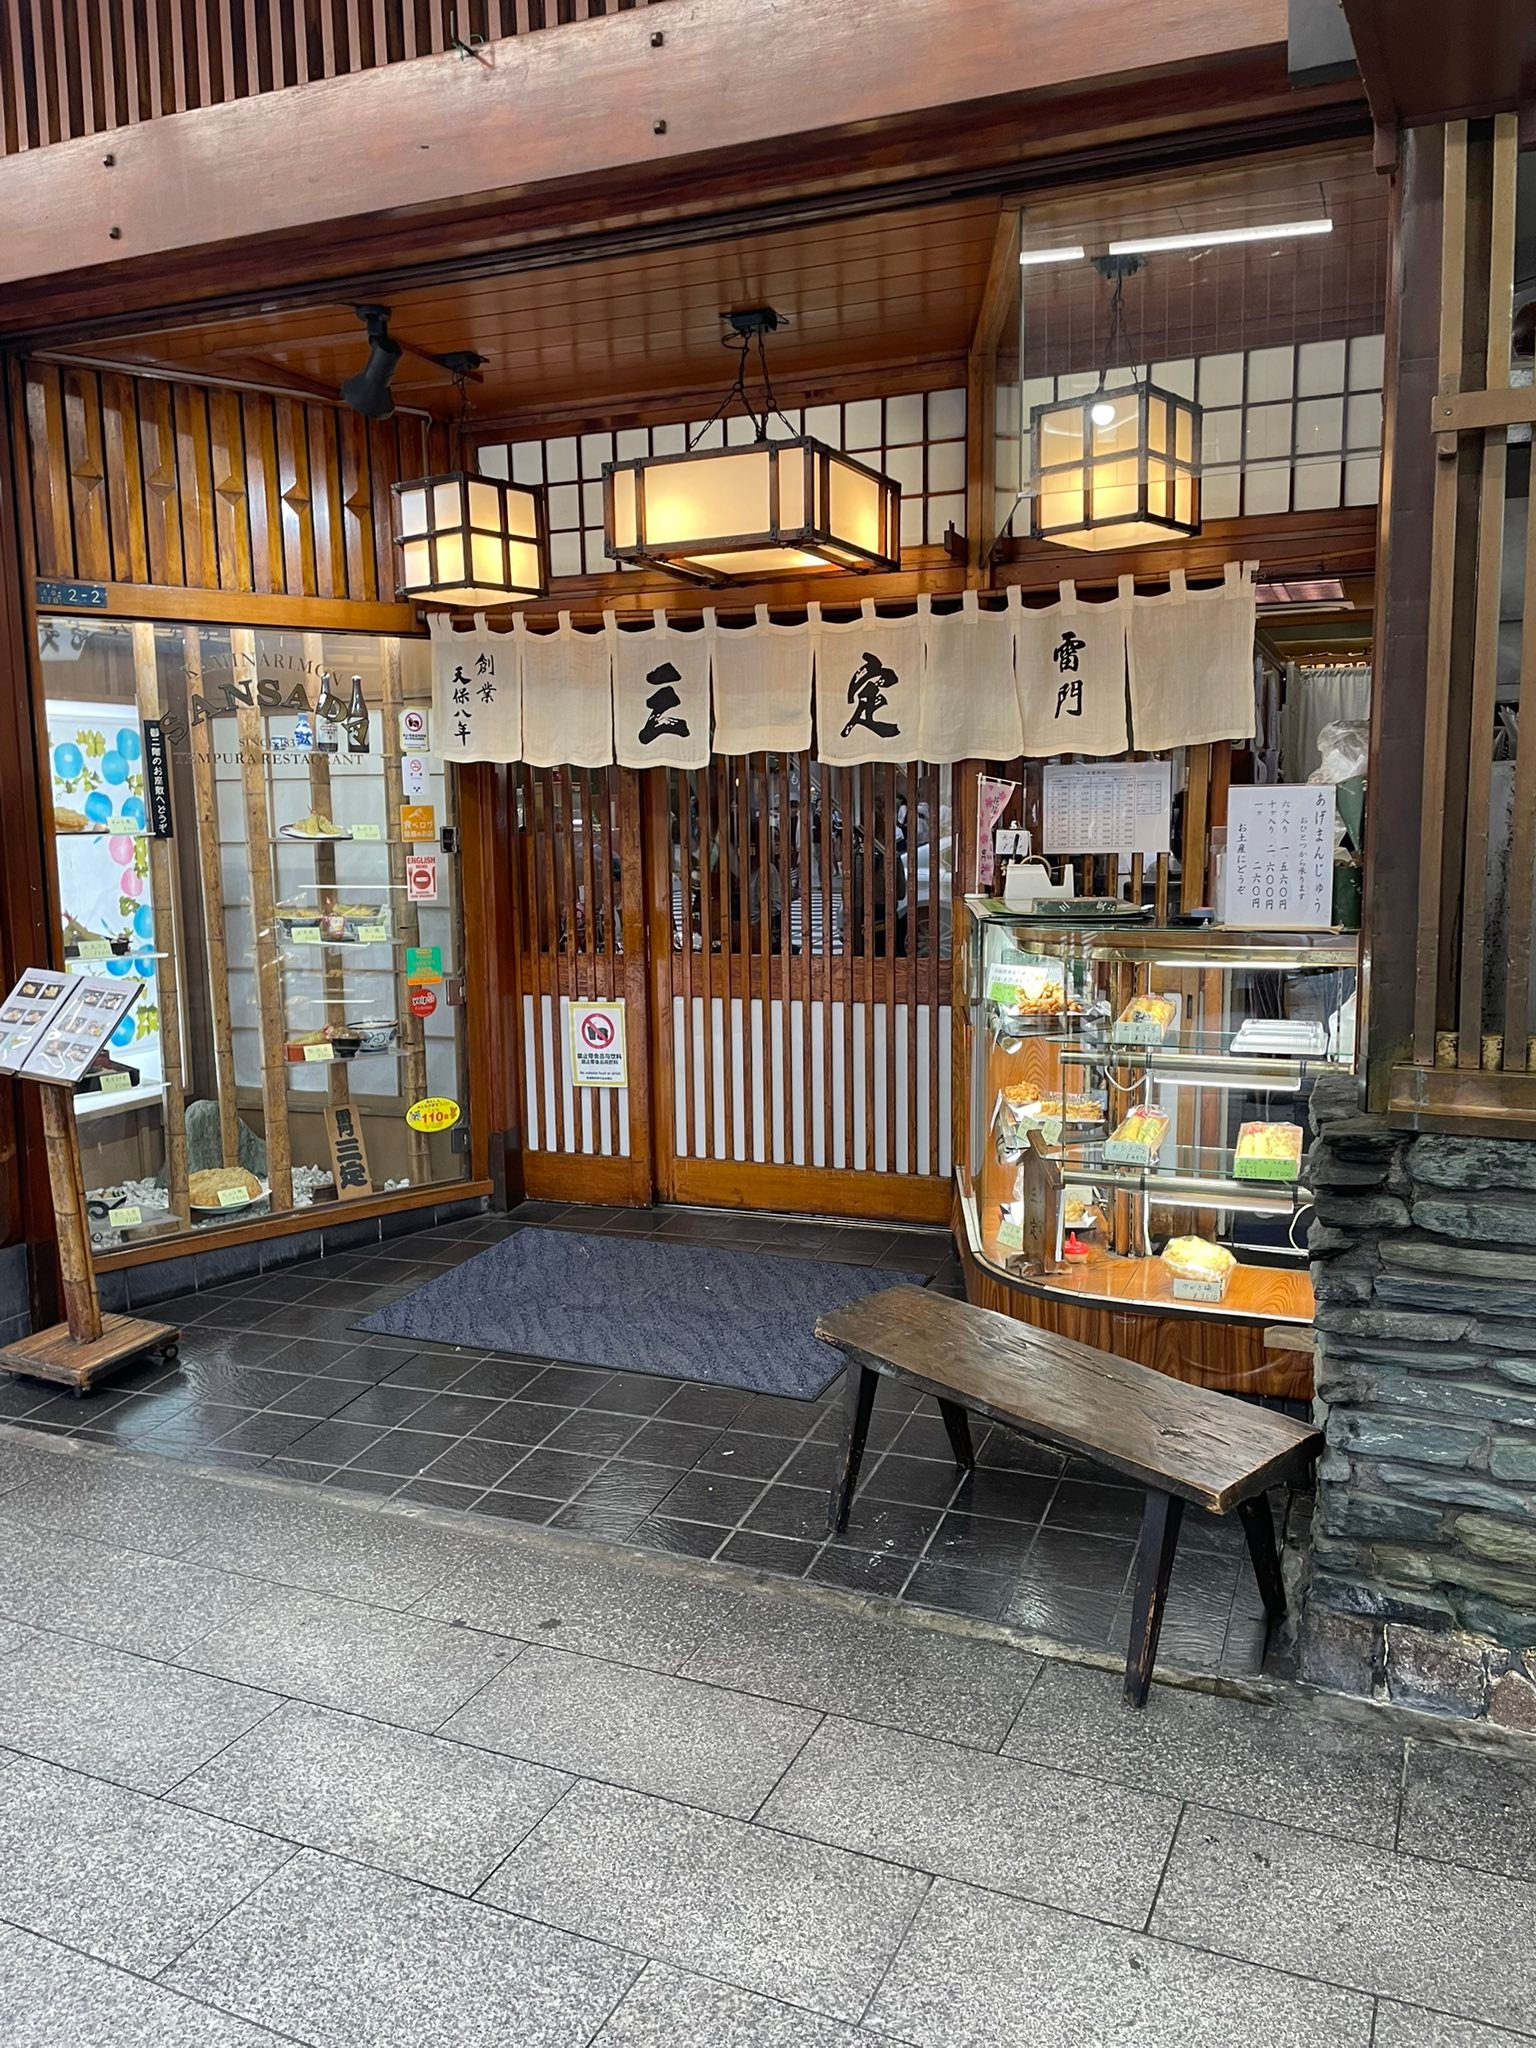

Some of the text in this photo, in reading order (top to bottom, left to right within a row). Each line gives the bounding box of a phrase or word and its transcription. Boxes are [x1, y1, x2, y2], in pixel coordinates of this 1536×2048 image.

[67, 587, 102, 604] 2-2
[452, 665, 472, 747] 天保八年
[474, 652, 497, 704] 創業
[1053, 630, 1086, 719] 雷門
[159, 678, 370, 748] SANSADA
[238, 737, 273, 748] SINC
[148, 727, 167, 834] 御二階のお座敷へどうぞ
[261, 753, 364, 765] RESTAUANT
[407, 856, 436, 865] ENGLISH
[1236, 823, 1248, 896] お土産にどうぞ
[1313, 792, 1327, 913] あげまんじゅう
